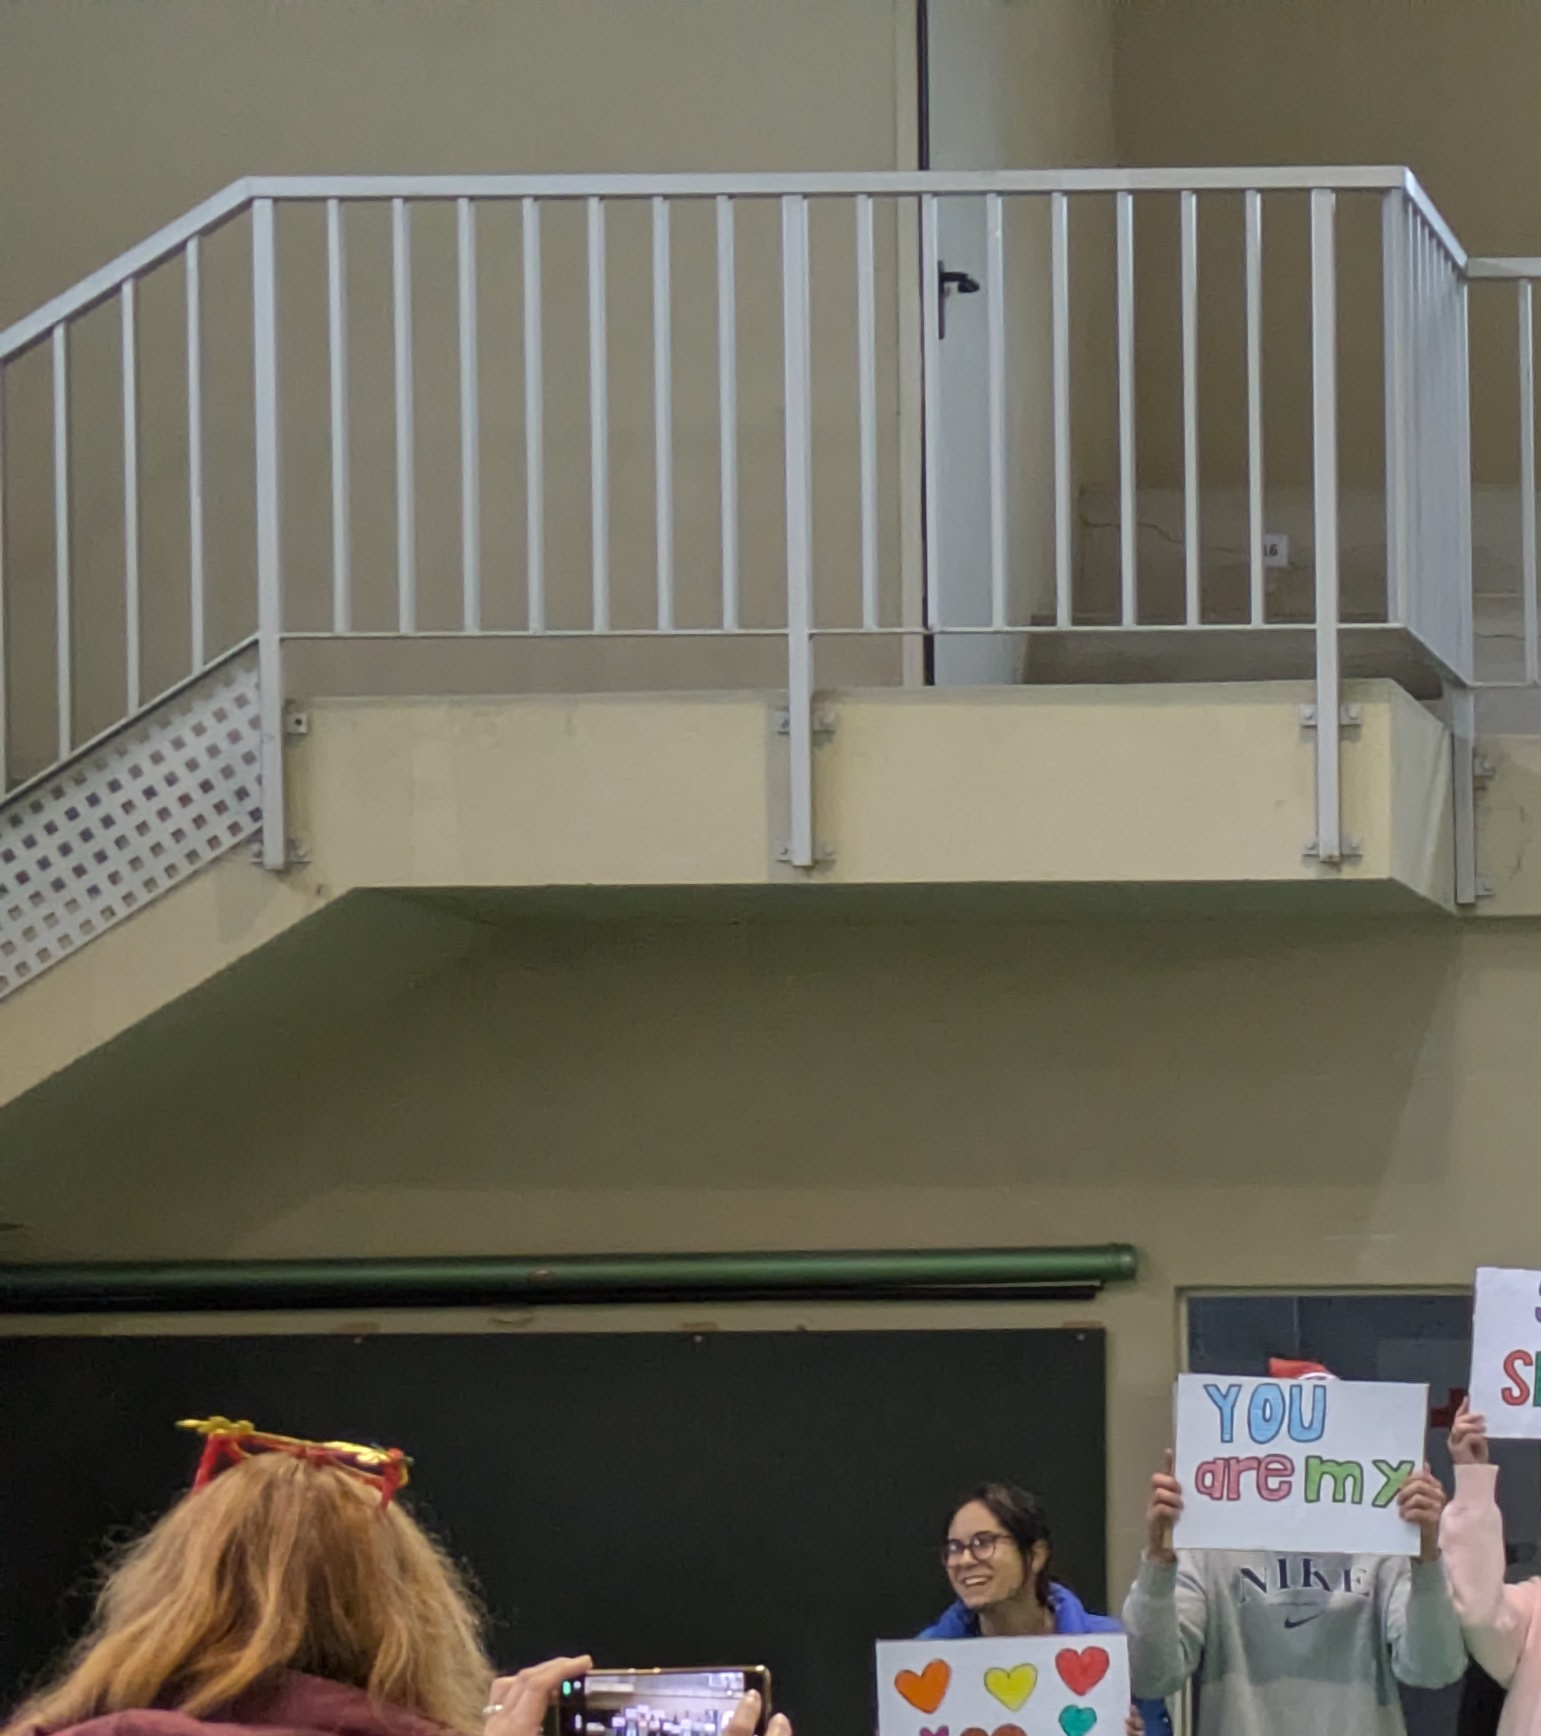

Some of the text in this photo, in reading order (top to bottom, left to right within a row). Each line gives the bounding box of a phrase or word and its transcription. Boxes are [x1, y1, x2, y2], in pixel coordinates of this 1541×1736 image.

[1203, 1383, 1327, 1444] YOU
[1195, 1453, 1415, 1508] are my
[1238, 1557, 1370, 1604] NIKE
